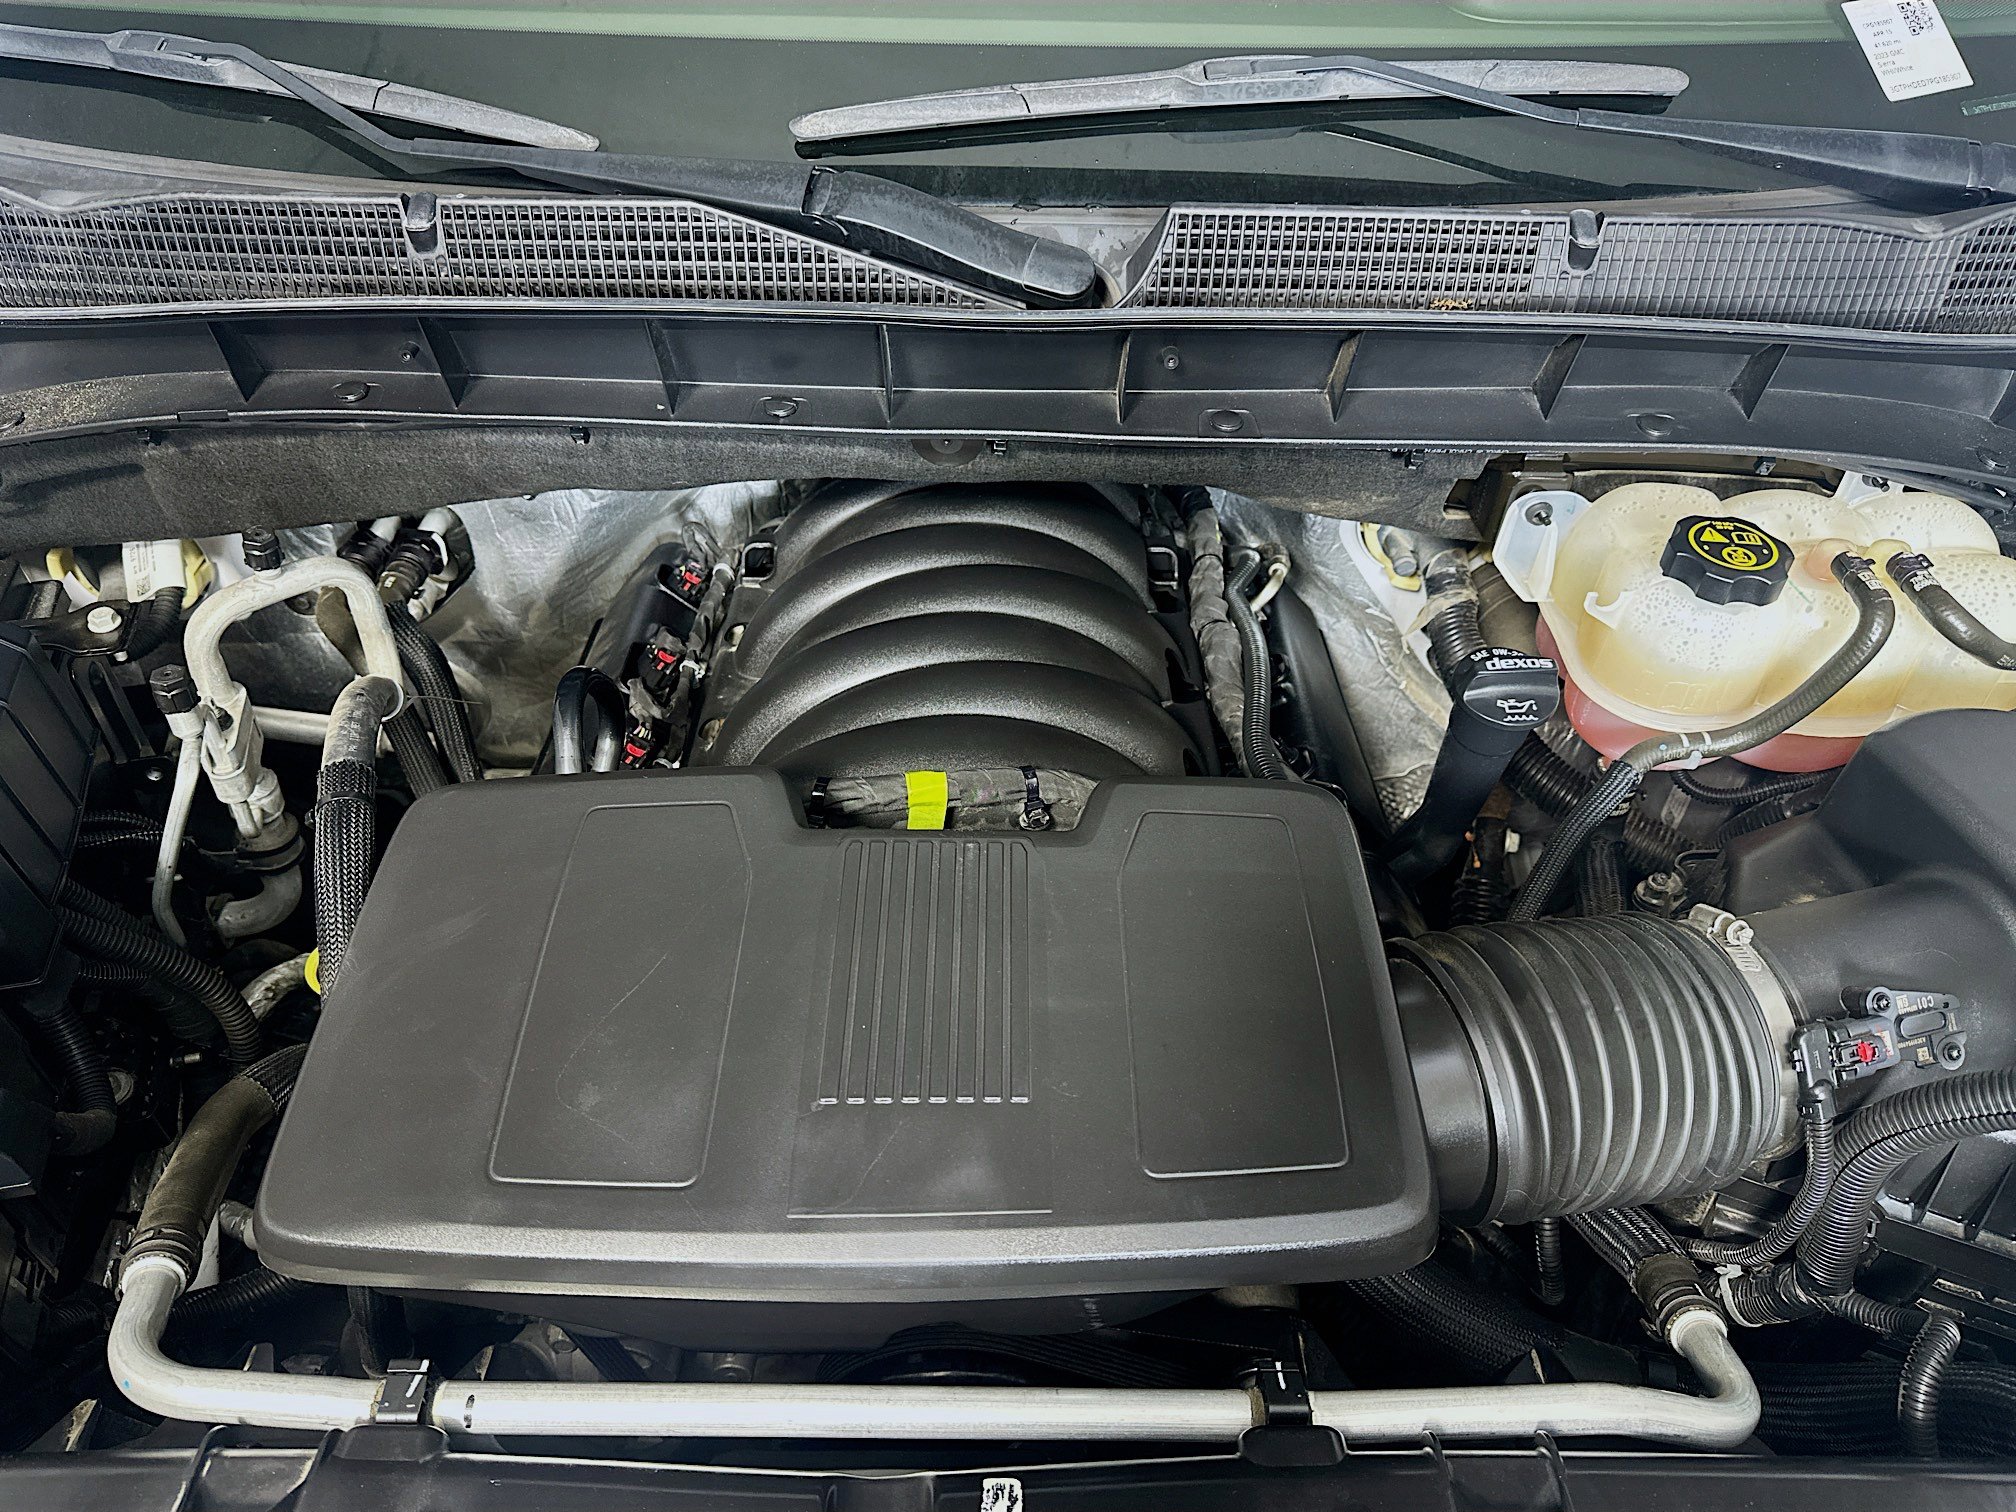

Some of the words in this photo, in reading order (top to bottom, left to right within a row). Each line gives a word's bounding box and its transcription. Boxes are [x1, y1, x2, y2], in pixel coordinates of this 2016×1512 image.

[1873, 51, 1889, 60] 2023
[1889, 48, 1905, 57] GMC
[1877, 60, 1896, 68] Sierra
[1470, 649, 1490, 661] SAE
[1485, 656, 1554, 671] dexos
[1917, 994, 1934, 1010] C01
